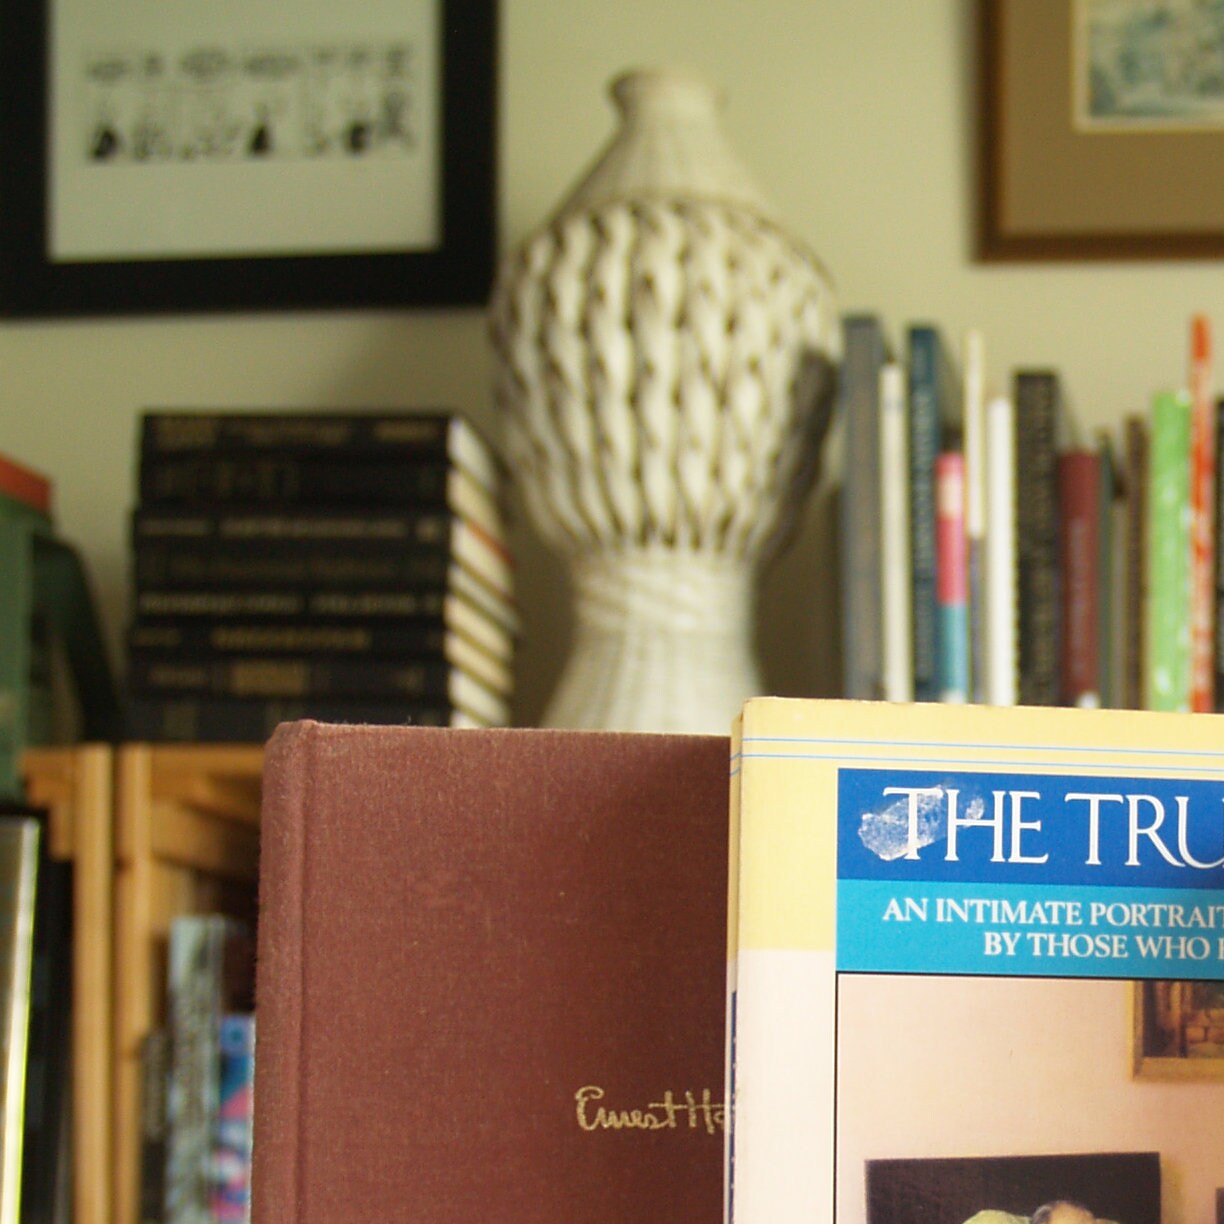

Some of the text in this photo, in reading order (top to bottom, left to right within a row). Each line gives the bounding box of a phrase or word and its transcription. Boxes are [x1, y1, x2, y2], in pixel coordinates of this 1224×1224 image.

[882, 785, 1049, 864] THE
[882, 897, 929, 922] AN
[935, 898, 1083, 925] INTIMATE
[984, 931, 1022, 956] BY
[1026, 932, 1129, 958] THOSE
[1135, 935, 1211, 960] WHO
